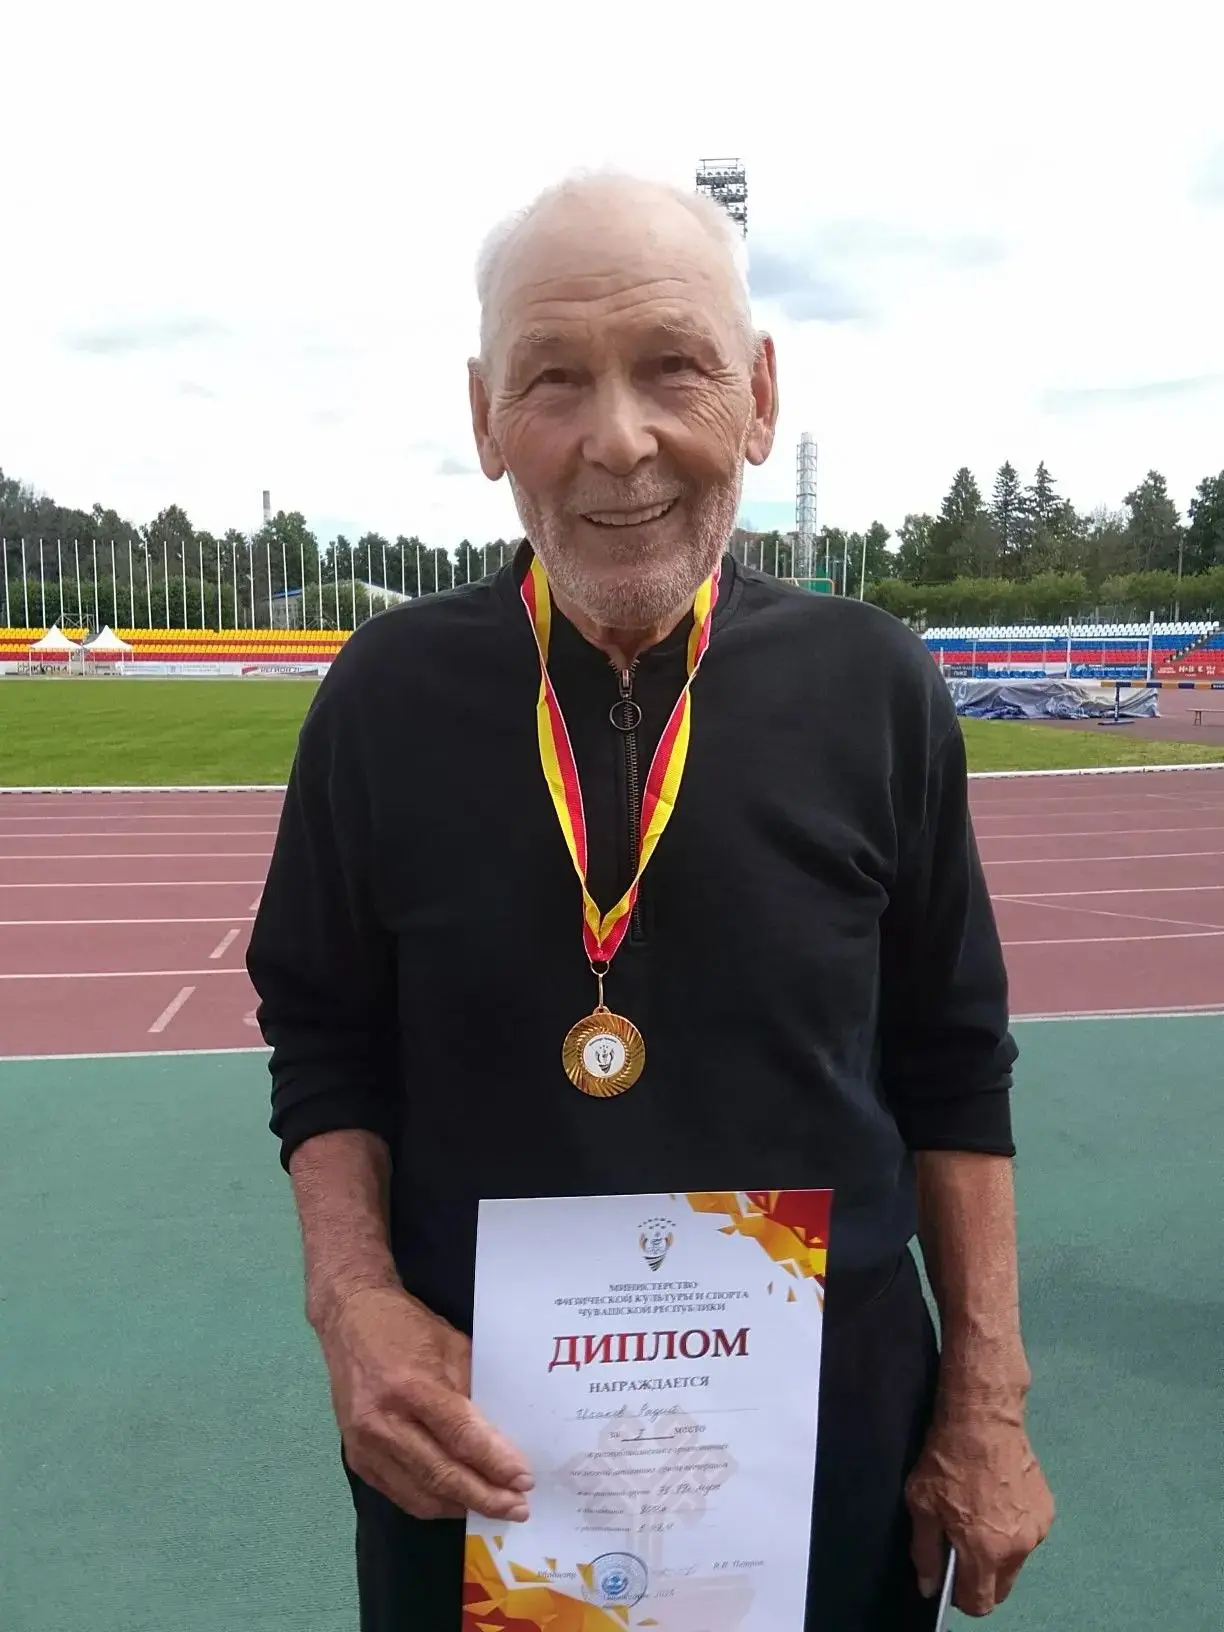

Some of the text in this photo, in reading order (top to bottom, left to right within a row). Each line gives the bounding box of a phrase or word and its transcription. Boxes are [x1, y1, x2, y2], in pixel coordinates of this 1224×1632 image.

[609, 1281, 698, 1292] МИНИСТЕРСТВО
[554, 1291, 749, 1306] ФИЗИЧЕСКОЙ КУЛЬТУРЫ И СПОРТА
[578, 1303, 726, 1319] ЧУВАШСКОЙ РЕСПУБЛИКИ
[548, 1327, 750, 1373] ДИПЛОМ
[589, 1376, 709, 1393] НАГРАЖДАЕТСЯ
[674, 1425, 706, 1436] место
